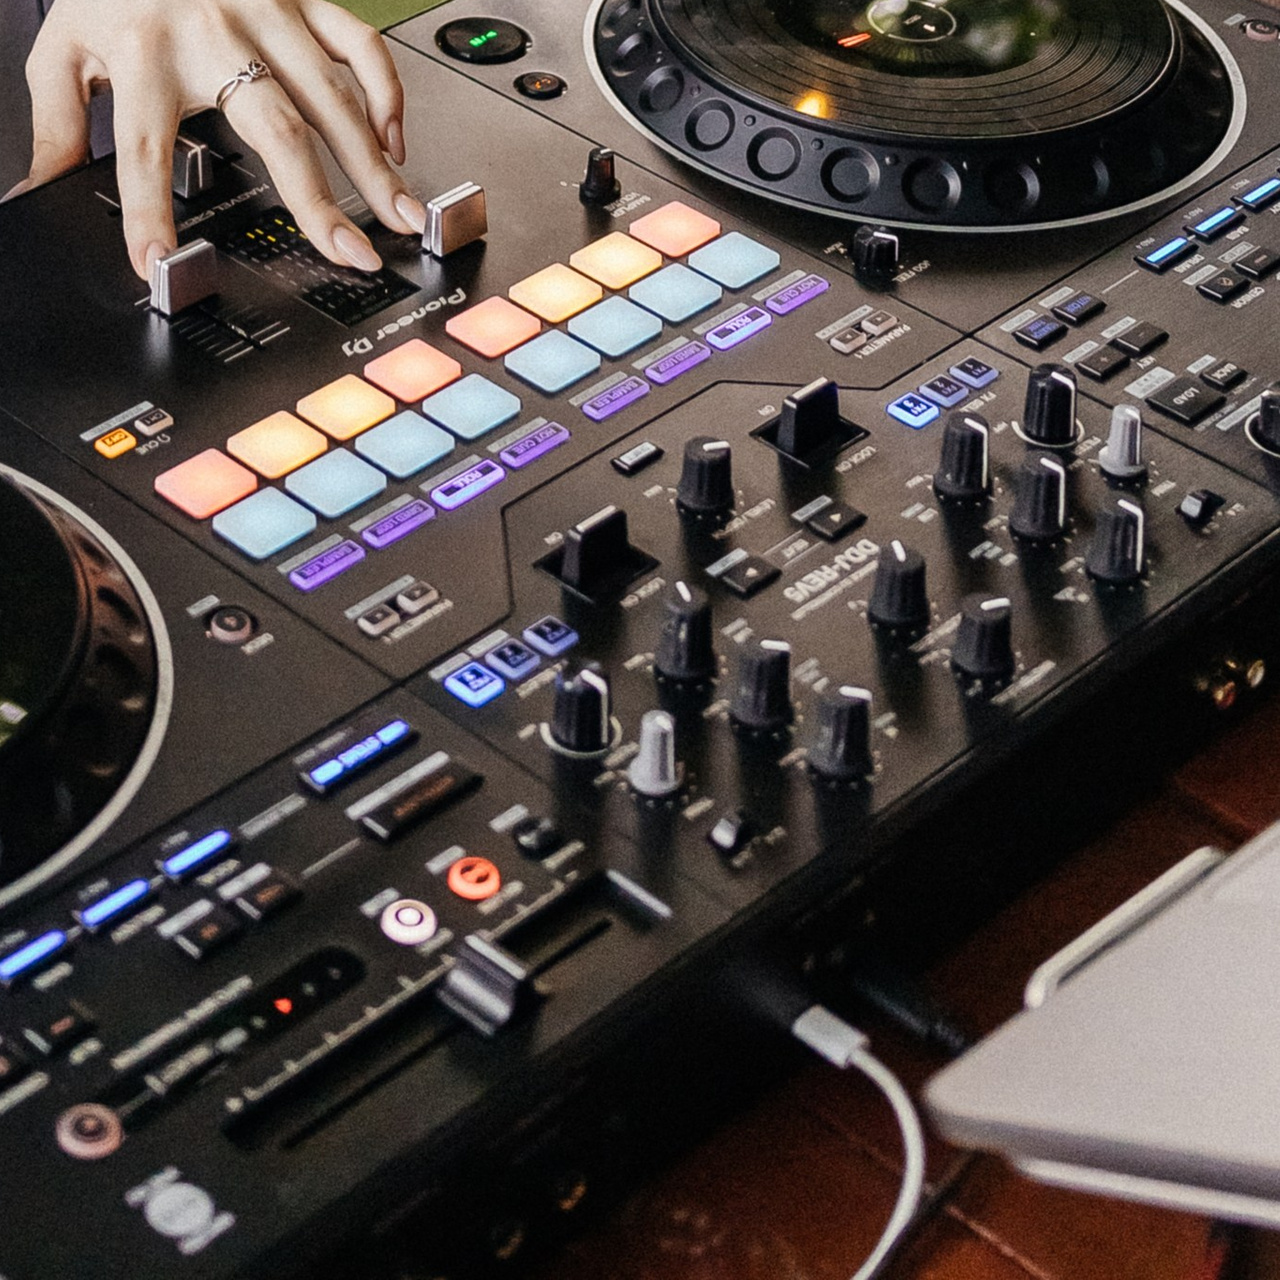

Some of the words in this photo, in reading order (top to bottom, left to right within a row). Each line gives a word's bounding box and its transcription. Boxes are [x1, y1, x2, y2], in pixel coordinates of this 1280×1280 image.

[211, 182, 270, 216] MAGVEL
[1173, 253, 1205, 273] DRUMS
[797, 279, 817, 292] HOT
[891, 270, 916, 283] FEEL
[778, 289, 799, 303] CUE
[1231, 286, 1265, 308] CENSOR
[377, 288, 467, 340] Pioneer
[724, 316, 752, 332] ROLL
[860, 323, 912, 356] PARAMETER
[1137, 355, 1156, 369] KEY
[1211, 362, 1238, 379] BACK
[593, 381, 637, 408] SAMPLER
[1173, 387, 1201, 405] LOAD
[535, 427, 557, 444] HOT
[135, 440, 159, 455] CUE
[512, 439, 536, 455] CUE
[848, 445, 877, 465] LOCK
[835, 460, 852, 473] ON
[453, 469, 483, 488] ROLL
[301, 545, 353, 577] SAMPLER
[783, 539, 880, 603] DDJ-REV5
